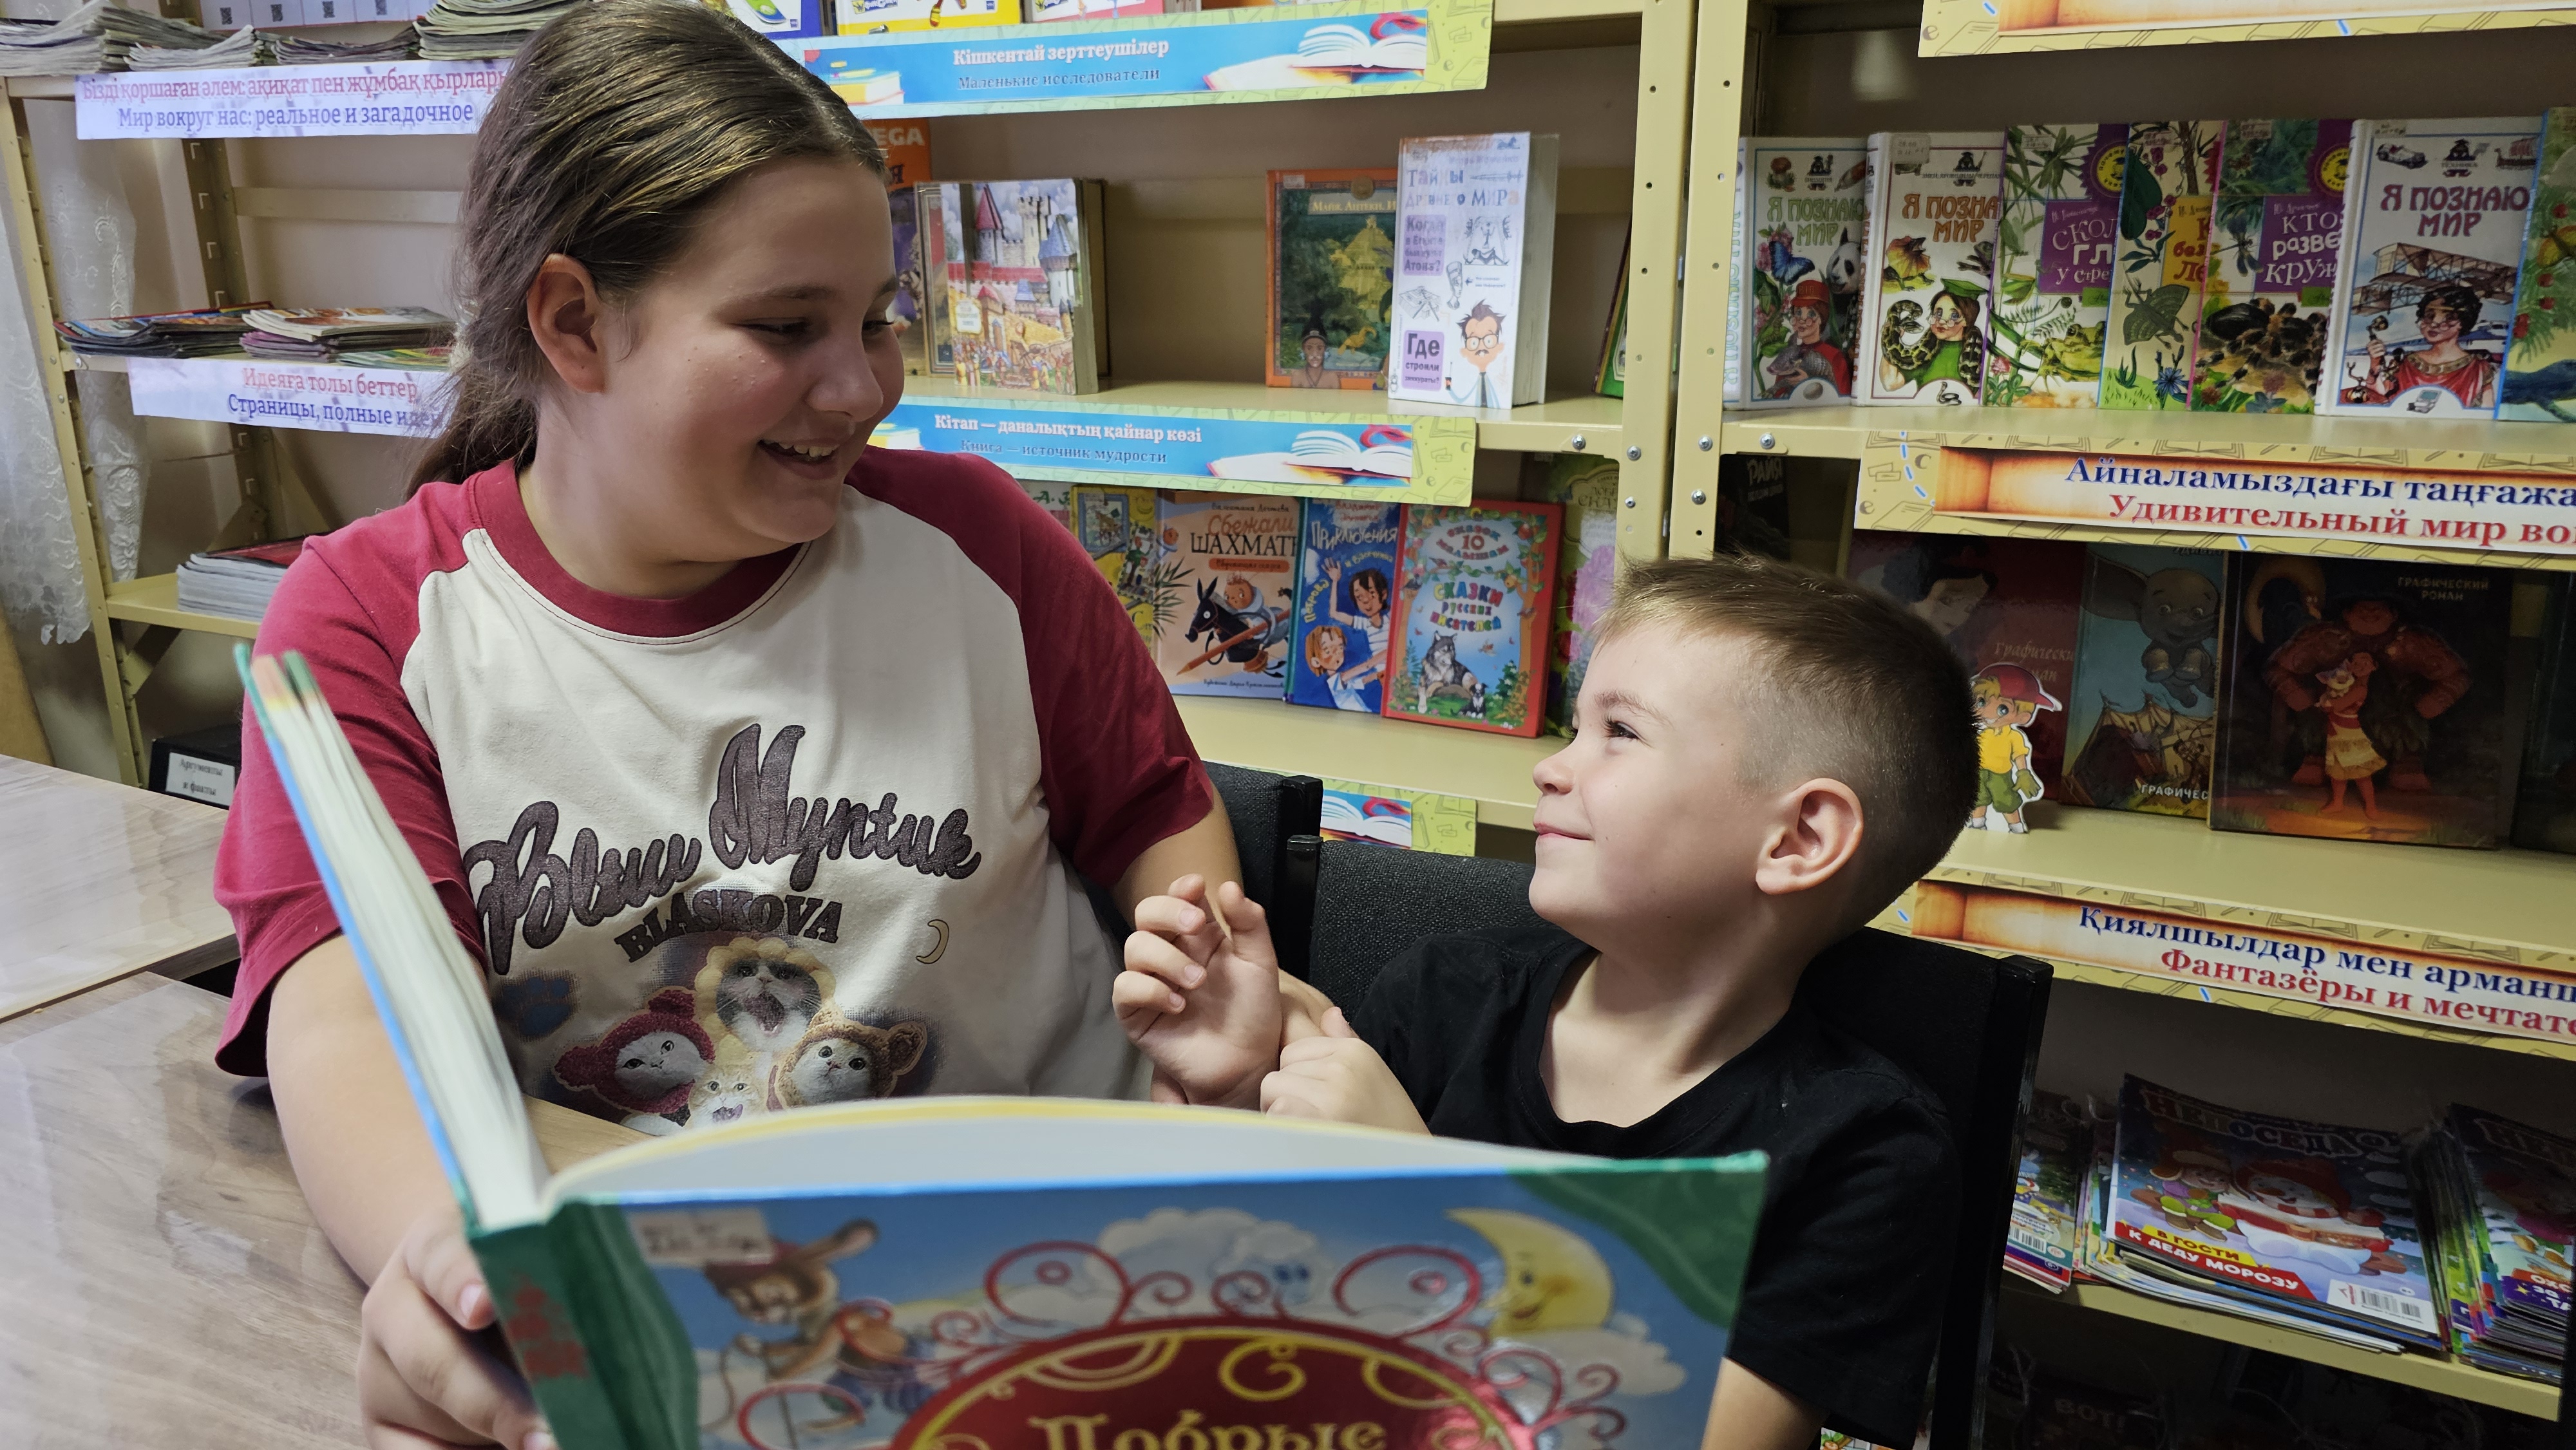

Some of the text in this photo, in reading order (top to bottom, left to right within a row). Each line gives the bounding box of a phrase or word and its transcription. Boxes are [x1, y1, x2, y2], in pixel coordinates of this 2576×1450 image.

[952, 38, 1170, 65] Кішкентай зерттеушілер
[312, 77, 344, 93] пен
[348, 67, 420, 98] жұмбақ
[958, 68, 1160, 90] Маленькие исследователи
[118, 104, 474, 133] Мир вокруг нас: реальное и загадочное
[1766, 196, 1783, 222] Я
[1902, 194, 1920, 219] Я
[2380, 184, 2530, 211] Я ПОЗНАЮ
[1795, 223, 1839, 247] МИР
[1933, 220, 1984, 243] МИР
[2418, 212, 2481, 237] МИР
[1407, 333, 1440, 359] Где
[1405, 362, 1439, 372] строили
[308, 376, 353, 393] толы
[357, 372, 417, 403] беттер
[228, 393, 319, 419] Страницы,
[323, 404, 392, 424] полные
[934, 414, 1202, 444] Кітап даналықтың қайнар көзі
[960, 440, 1167, 464] Книга источник мудрости
[2065, 457, 2396, 500] Айналамыздағы
[1208, 514, 1294, 536] Сбежали
[2108, 494, 2576, 548] Удивительный мир во
[1462, 534, 1484, 550] 10
[1434, 581, 1503, 607] СКАЗКИ
[614, 890, 842, 963] BLASKOVA
[2080, 906, 2326, 968] Қиялшылдар
[2336, 952, 2413, 980] мен
[2161, 947, 2375, 1004] Фантазёры
[2386, 989, 2413, 1012] и
[2157, 1229, 2240, 1261] В ГОСТИ
[2128, 1229, 2299, 1290] К ДЕДУ МОРОЗУ
